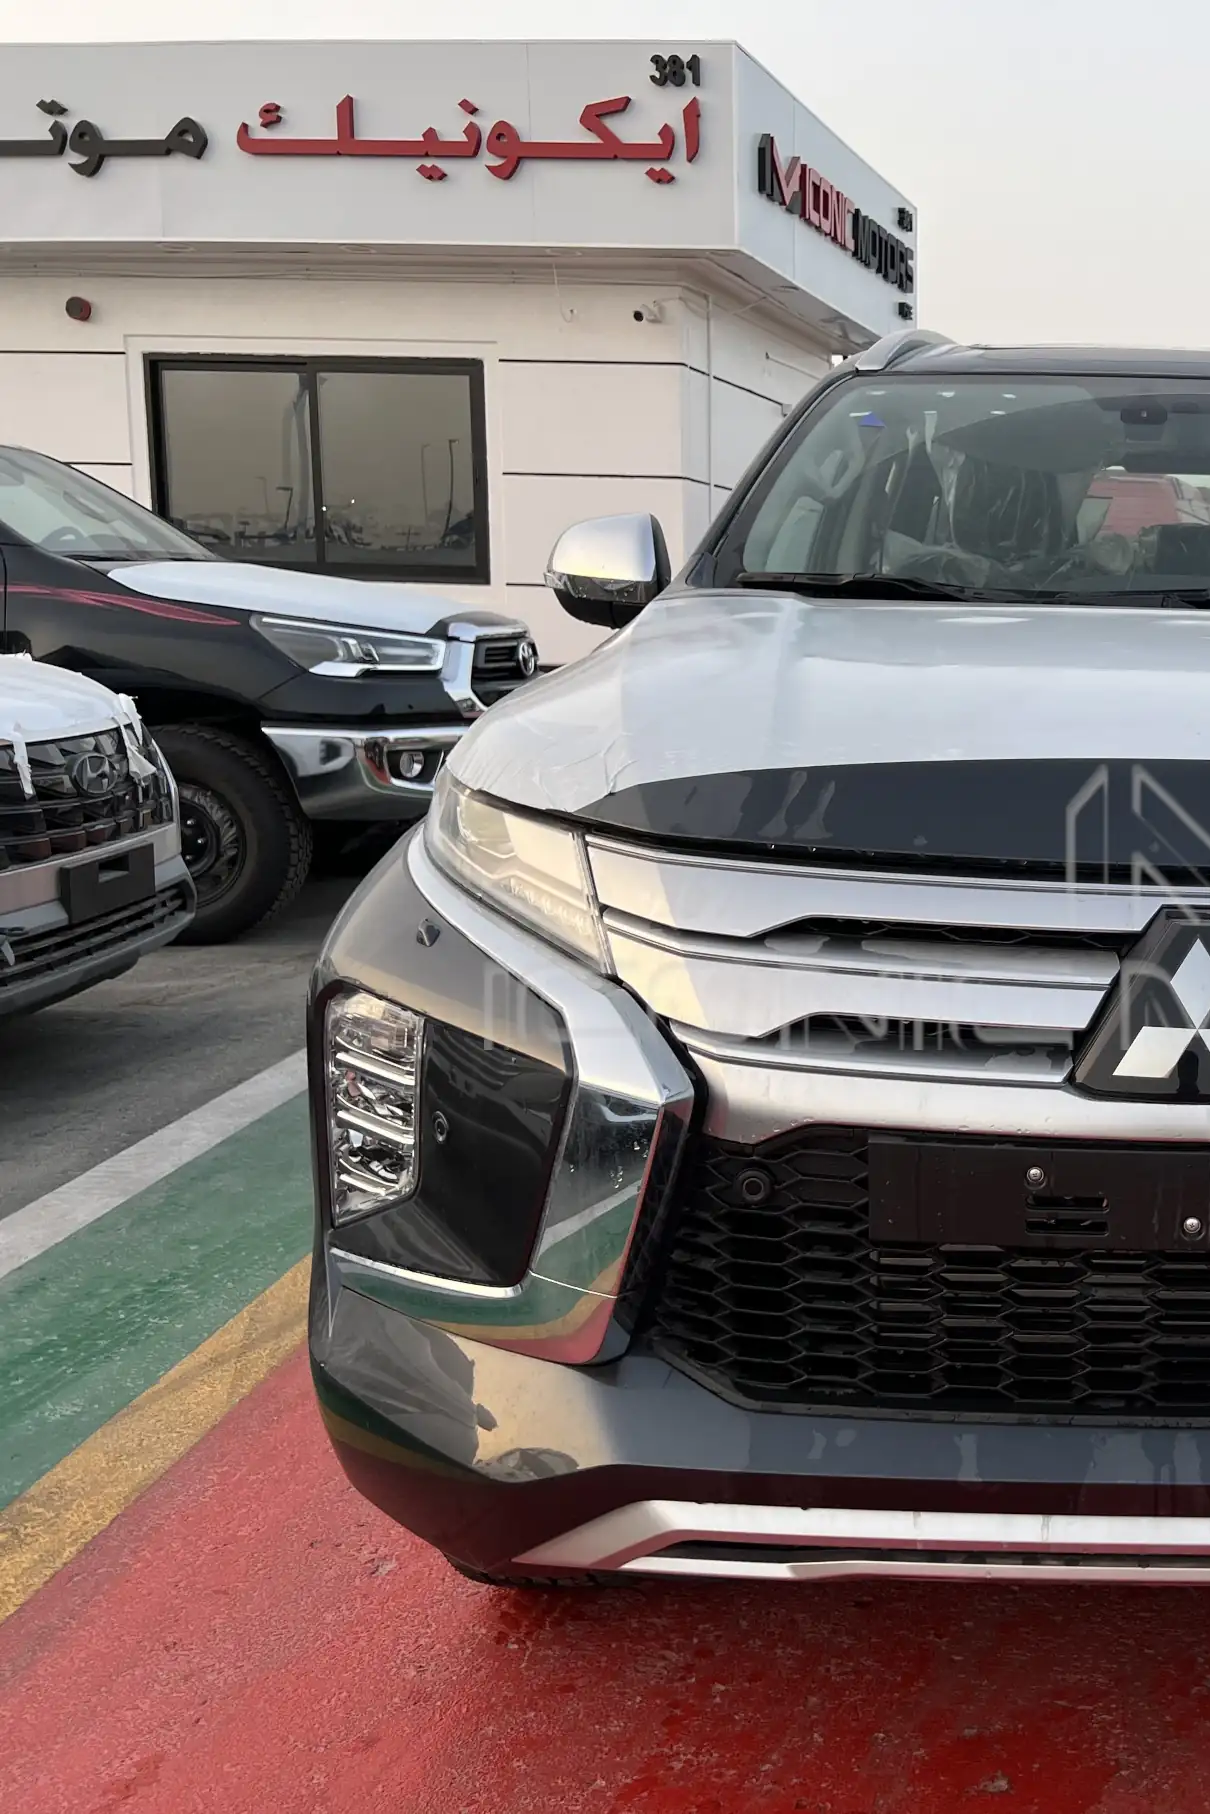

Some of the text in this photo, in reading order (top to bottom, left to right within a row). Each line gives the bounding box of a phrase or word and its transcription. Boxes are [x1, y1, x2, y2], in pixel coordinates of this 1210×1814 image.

[648, 54, 701, 88] 381
[799, 162, 856, 252] ICONIC
[852, 207, 914, 294] MOTORS
